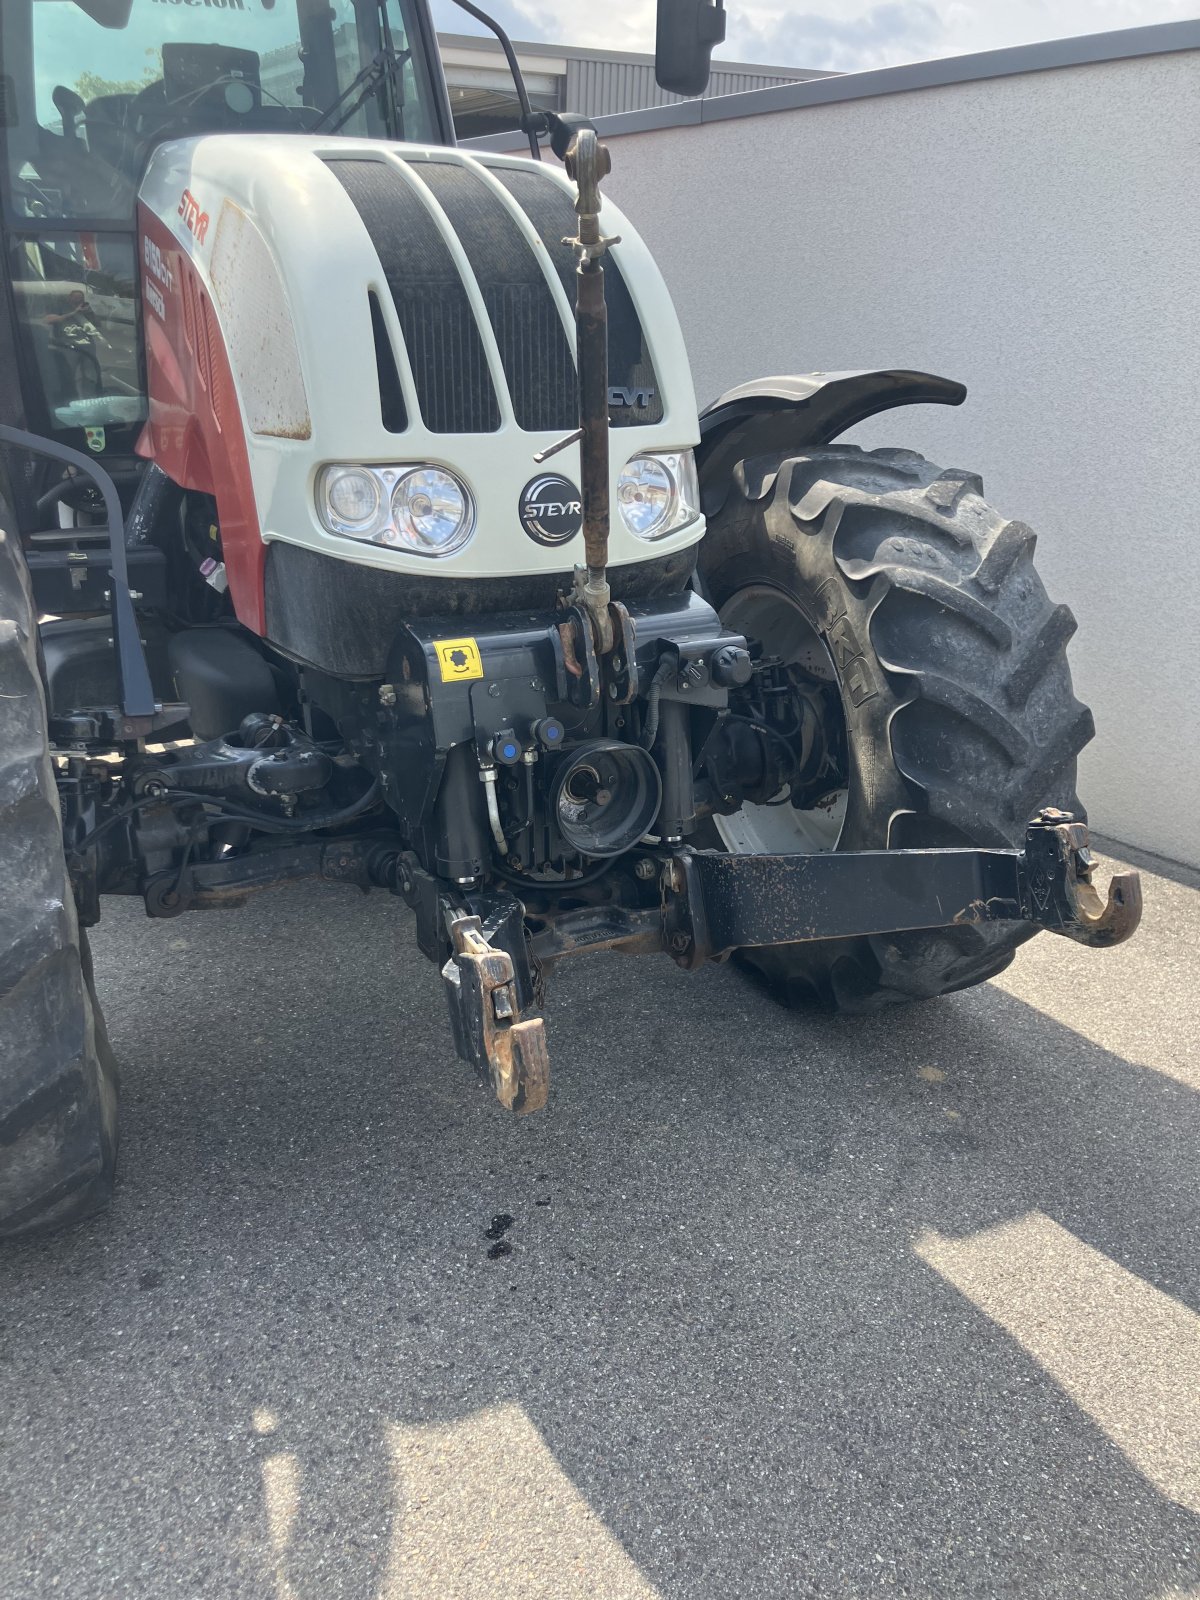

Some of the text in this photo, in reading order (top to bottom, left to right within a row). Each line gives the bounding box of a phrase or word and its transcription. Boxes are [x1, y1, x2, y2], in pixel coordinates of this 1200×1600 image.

[178, 188, 209, 247] STEYR
[607, 386, 654, 406] CVT
[523, 501, 581, 519] STEYR
